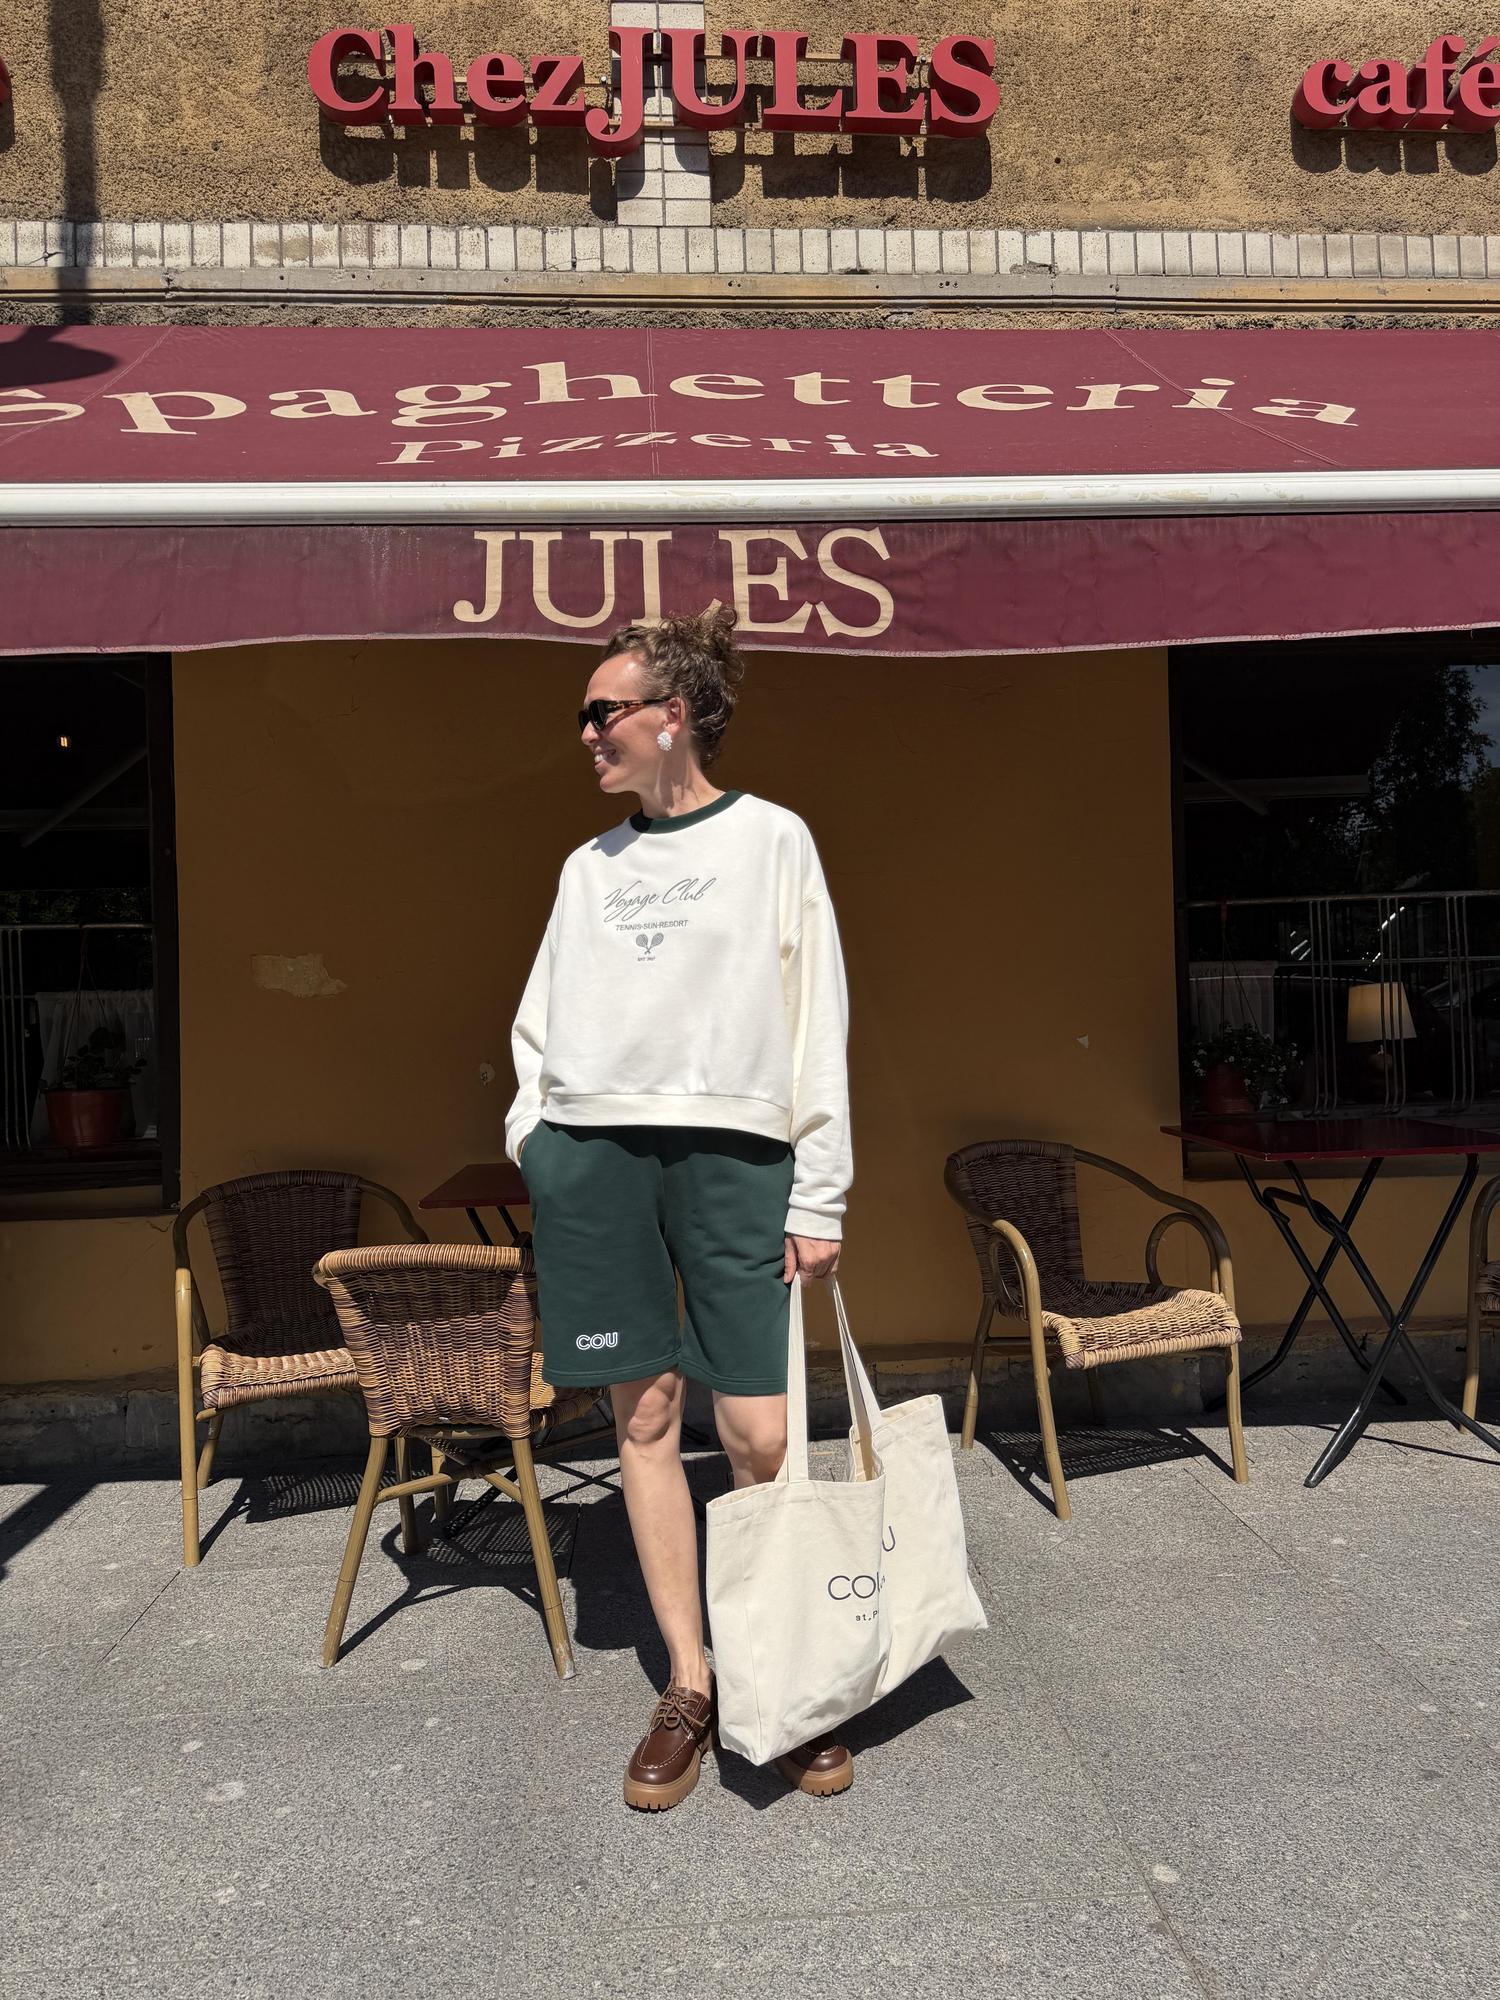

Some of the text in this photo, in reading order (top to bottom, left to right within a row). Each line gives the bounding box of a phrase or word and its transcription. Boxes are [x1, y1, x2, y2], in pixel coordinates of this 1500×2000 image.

[308, 24, 1000, 158] Chez JULES
[1292, 34, 1500, 133] café
[377, 430, 940, 465] Pizzeria
[453, 527, 894, 639] JULES
[603, 877, 717, 922] Voyage Club
[576, 1331, 618, 1350] COU
